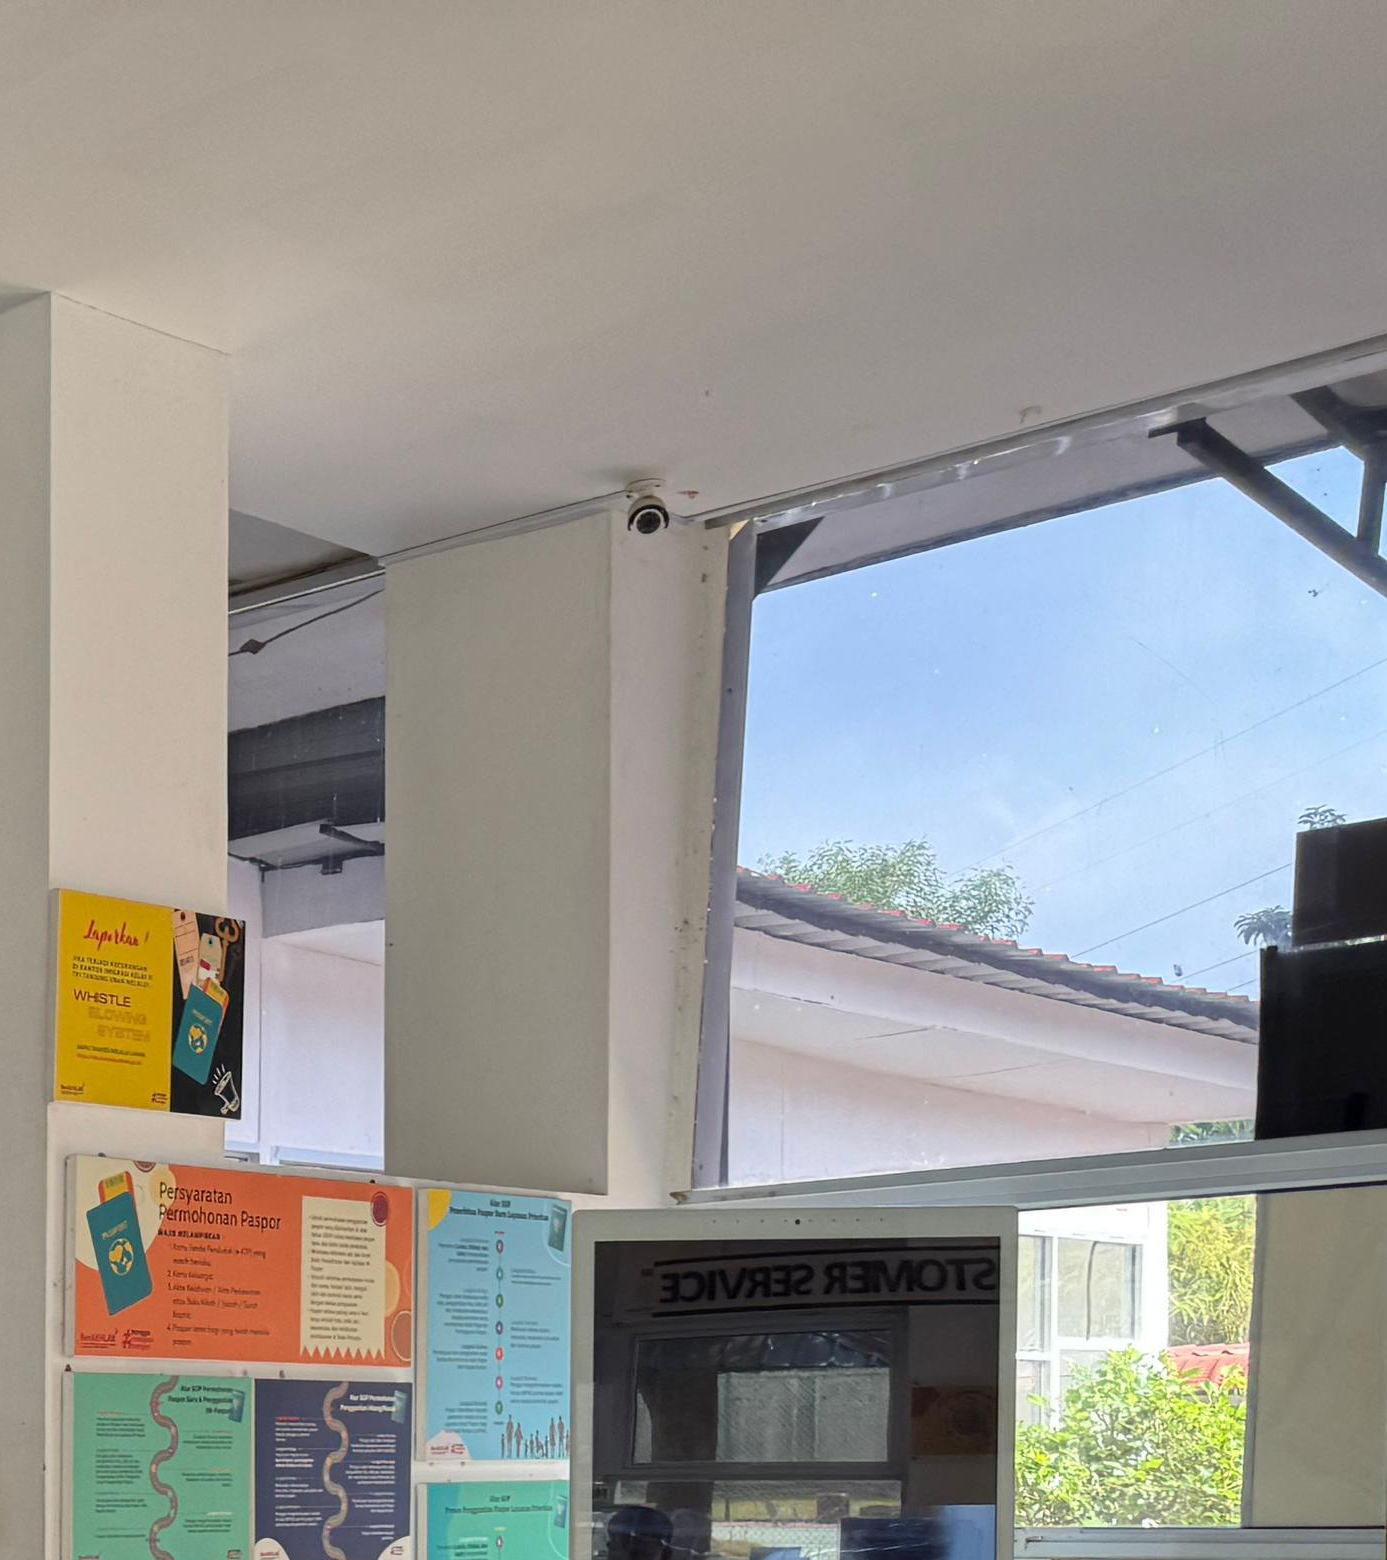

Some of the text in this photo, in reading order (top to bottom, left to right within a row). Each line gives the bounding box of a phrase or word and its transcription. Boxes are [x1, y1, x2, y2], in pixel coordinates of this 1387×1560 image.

[73, 988, 132, 1008] WHISTLE
[159, 1181, 233, 1206] Persyaratan
[158, 1203, 281, 1233] Permohonan Paspor
